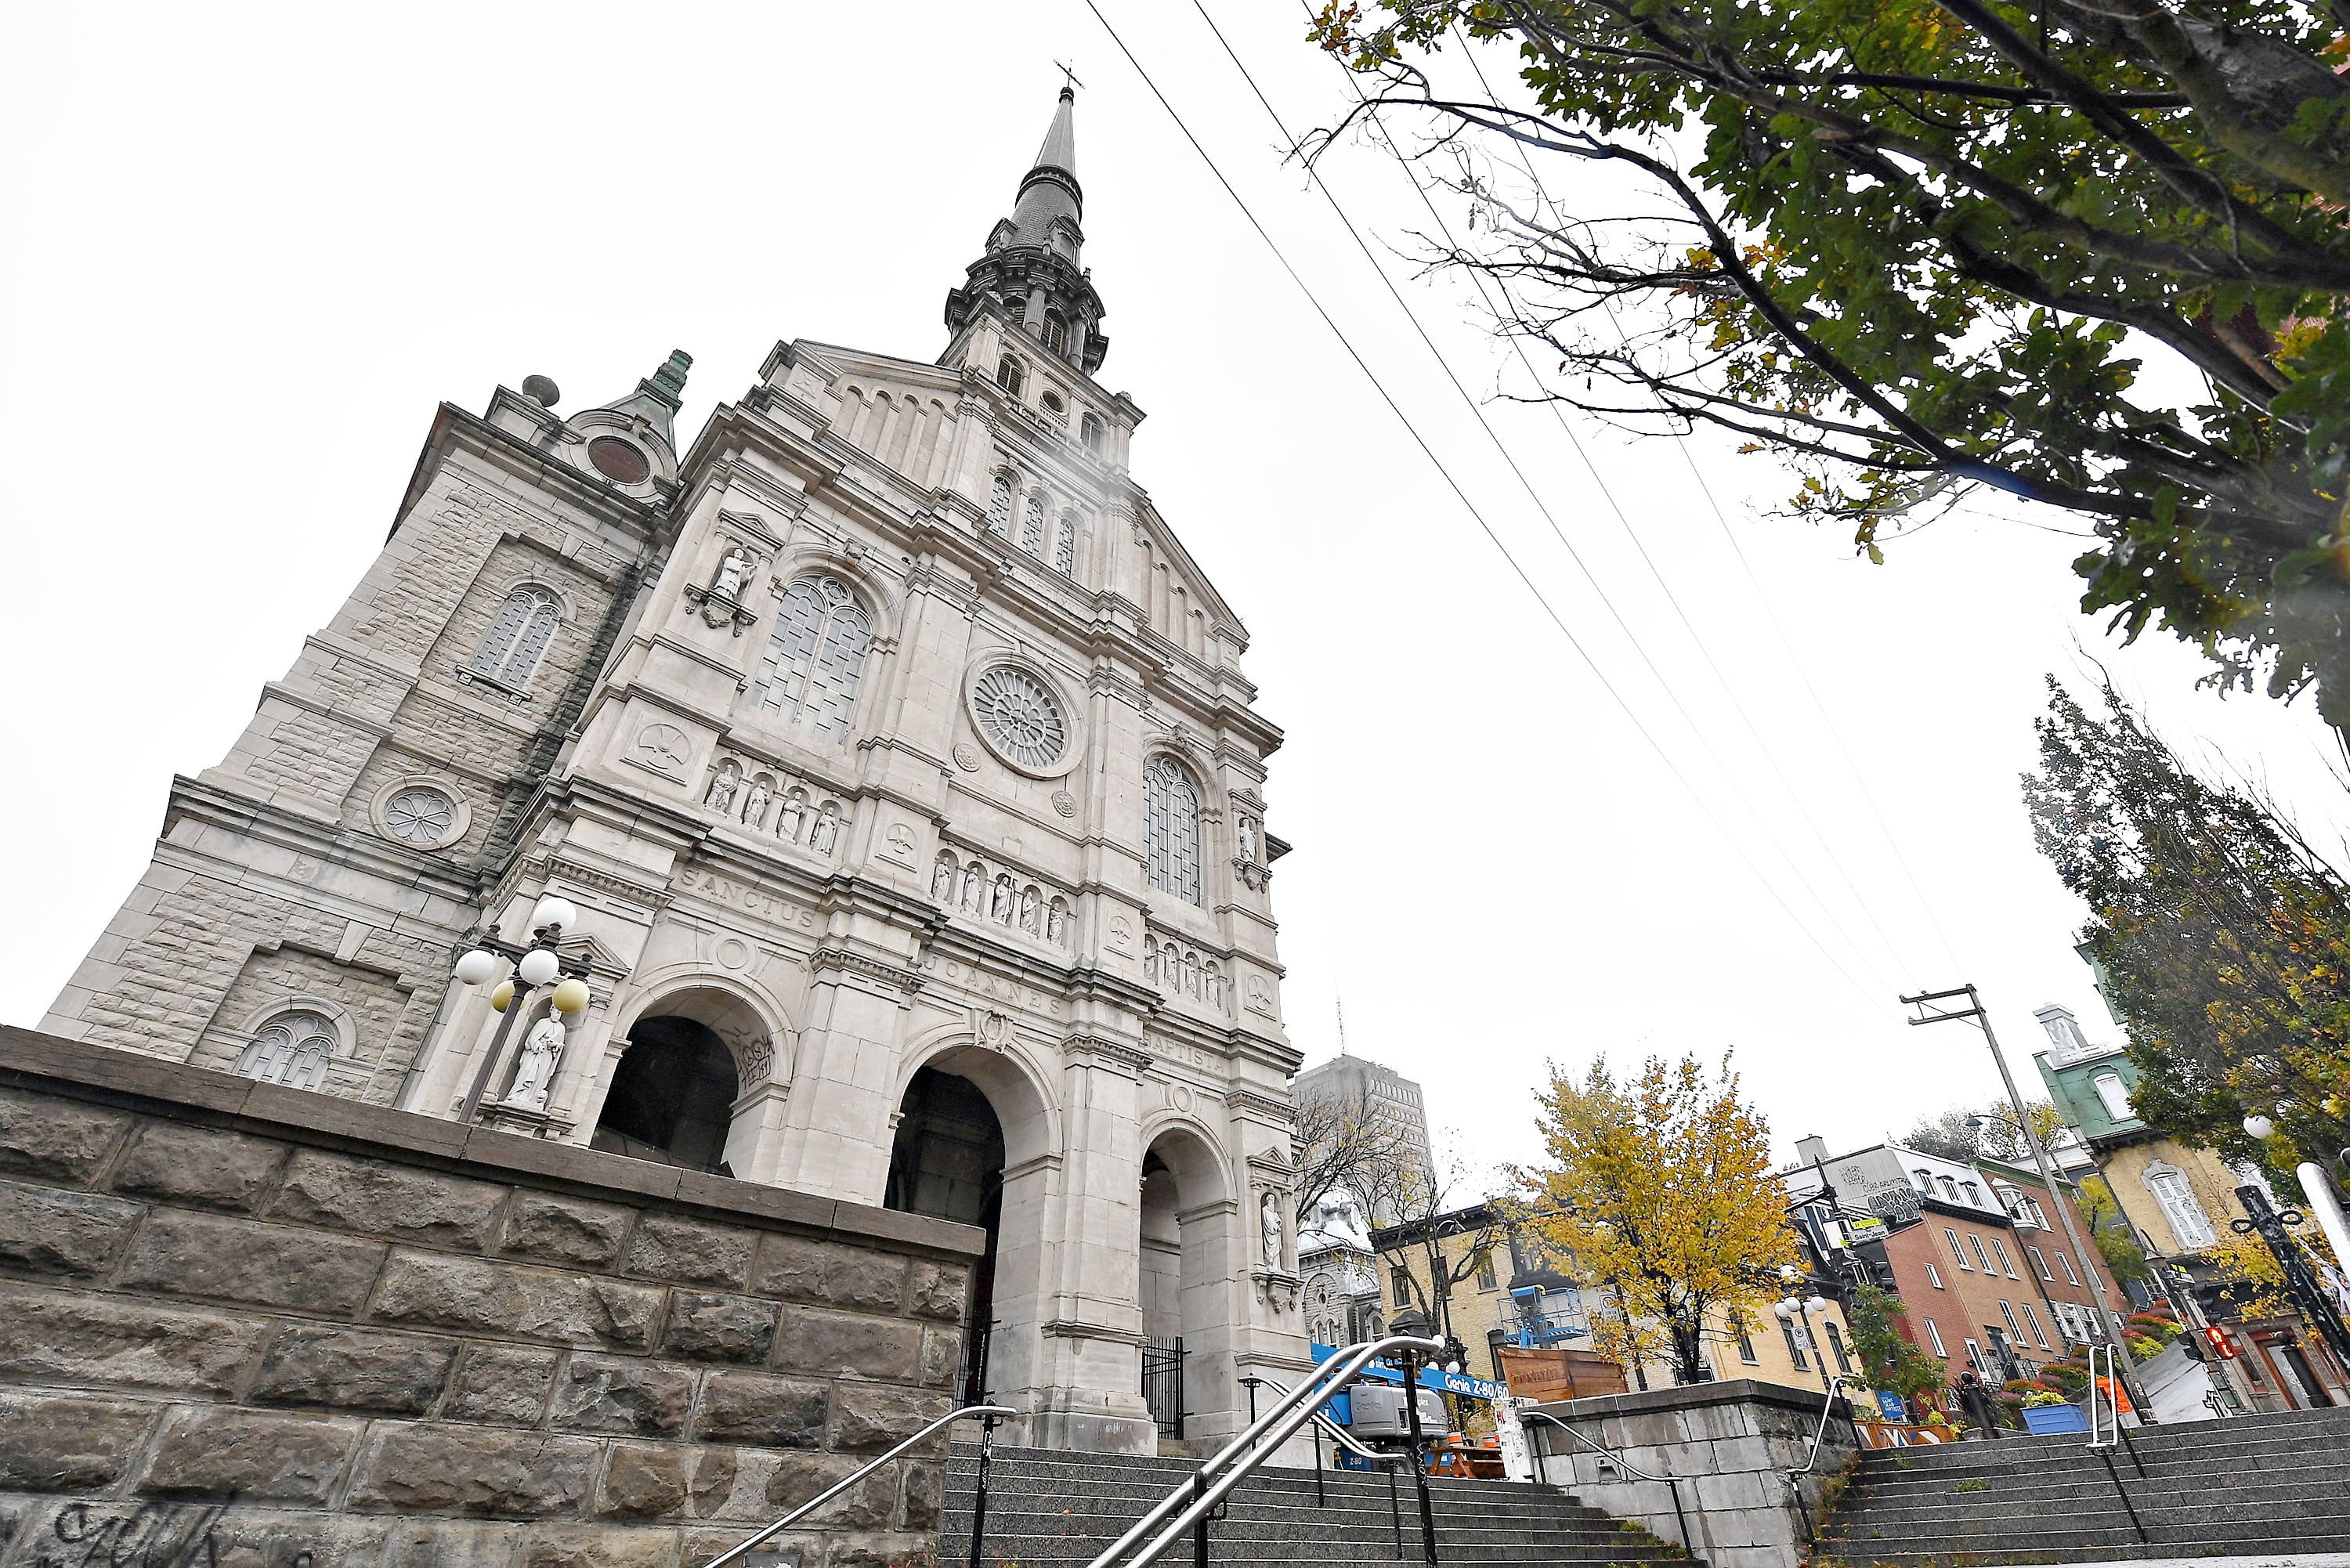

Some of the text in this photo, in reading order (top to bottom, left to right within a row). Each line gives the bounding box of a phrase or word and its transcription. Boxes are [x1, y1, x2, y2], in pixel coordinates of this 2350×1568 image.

[681, 869, 1224, 1073] SANCTUS JOANNES BAPTISTA
[1854, 1230, 1885, 1240] Saint-Jean
[1444, 1374, 1509, 1399] Genie Z-80/60
[1349, 1457, 1362, 1465] Z-80
